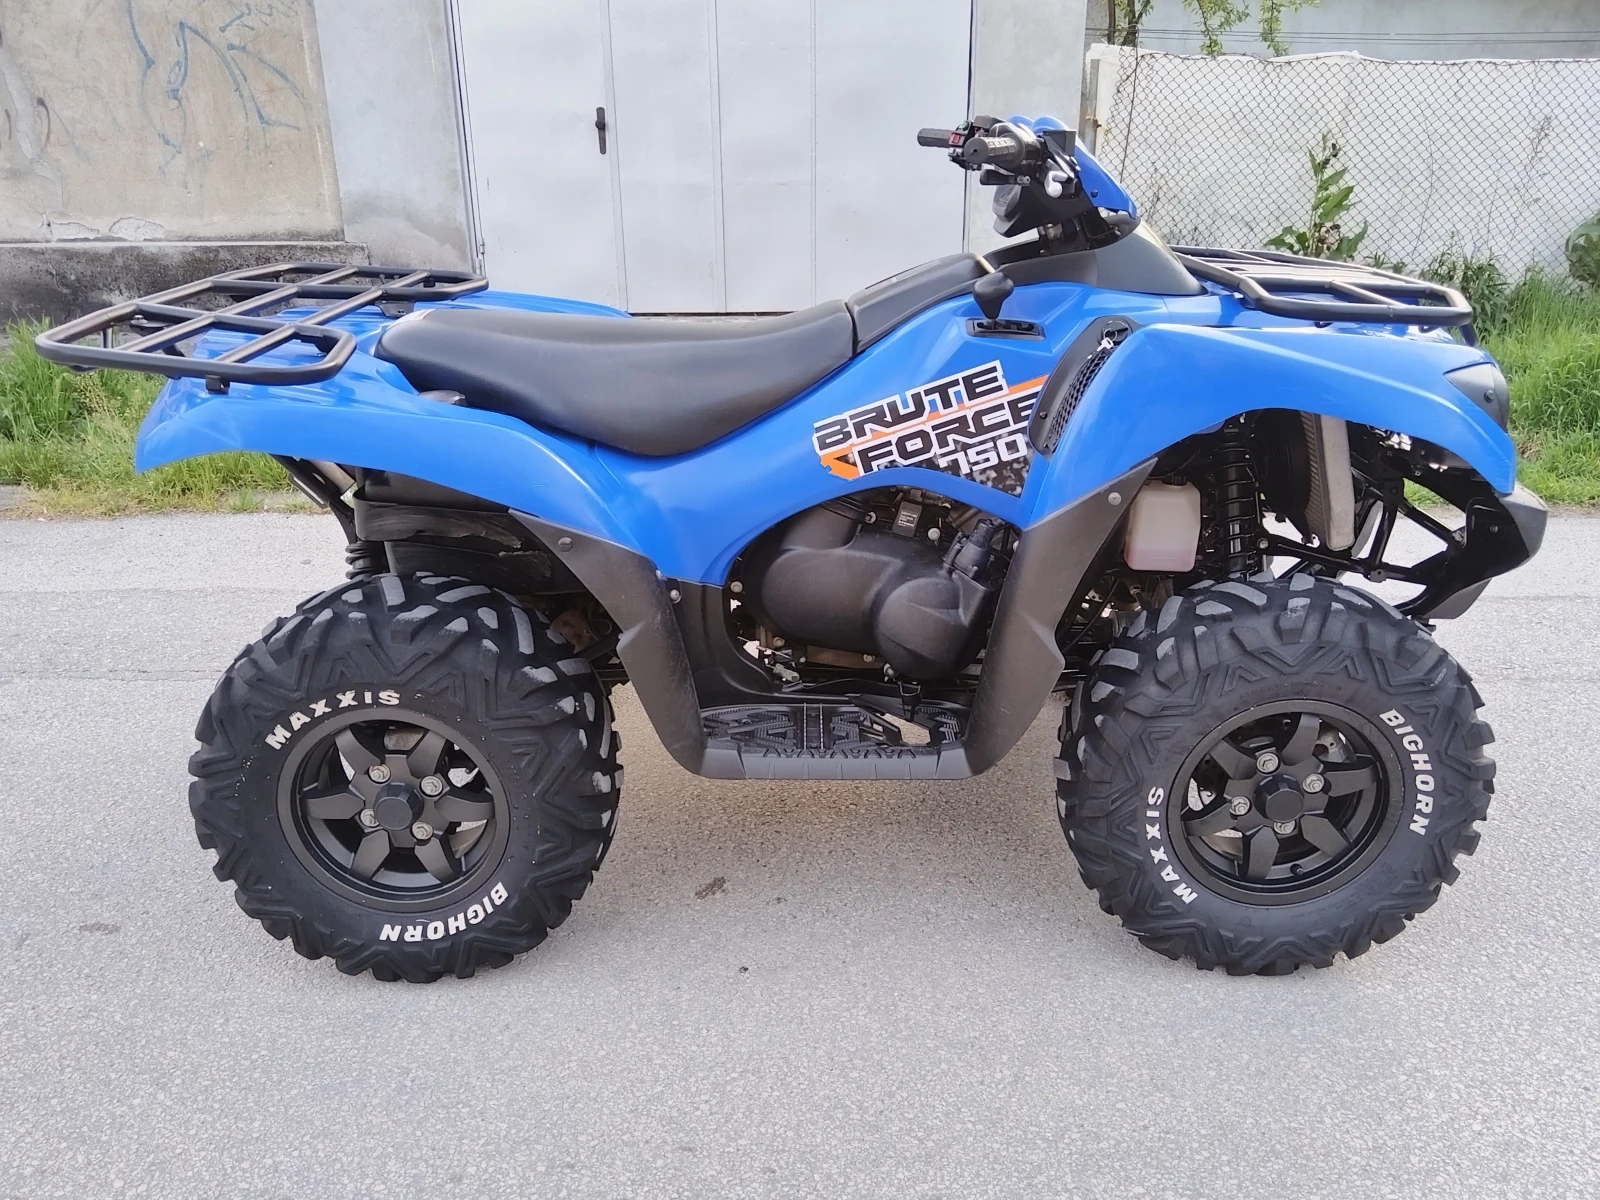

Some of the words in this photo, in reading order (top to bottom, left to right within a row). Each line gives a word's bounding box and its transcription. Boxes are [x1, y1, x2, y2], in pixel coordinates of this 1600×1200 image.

[814, 362, 1006, 452] BRUTE
[857, 391, 1038, 474] FORCE
[938, 432, 1028, 474] 750
[266, 689, 400, 749] MAXXIS
[1380, 708, 1434, 835] BIGHORN
[1145, 787, 1198, 904] MAXXIS
[379, 882, 508, 942] BIGHORN
